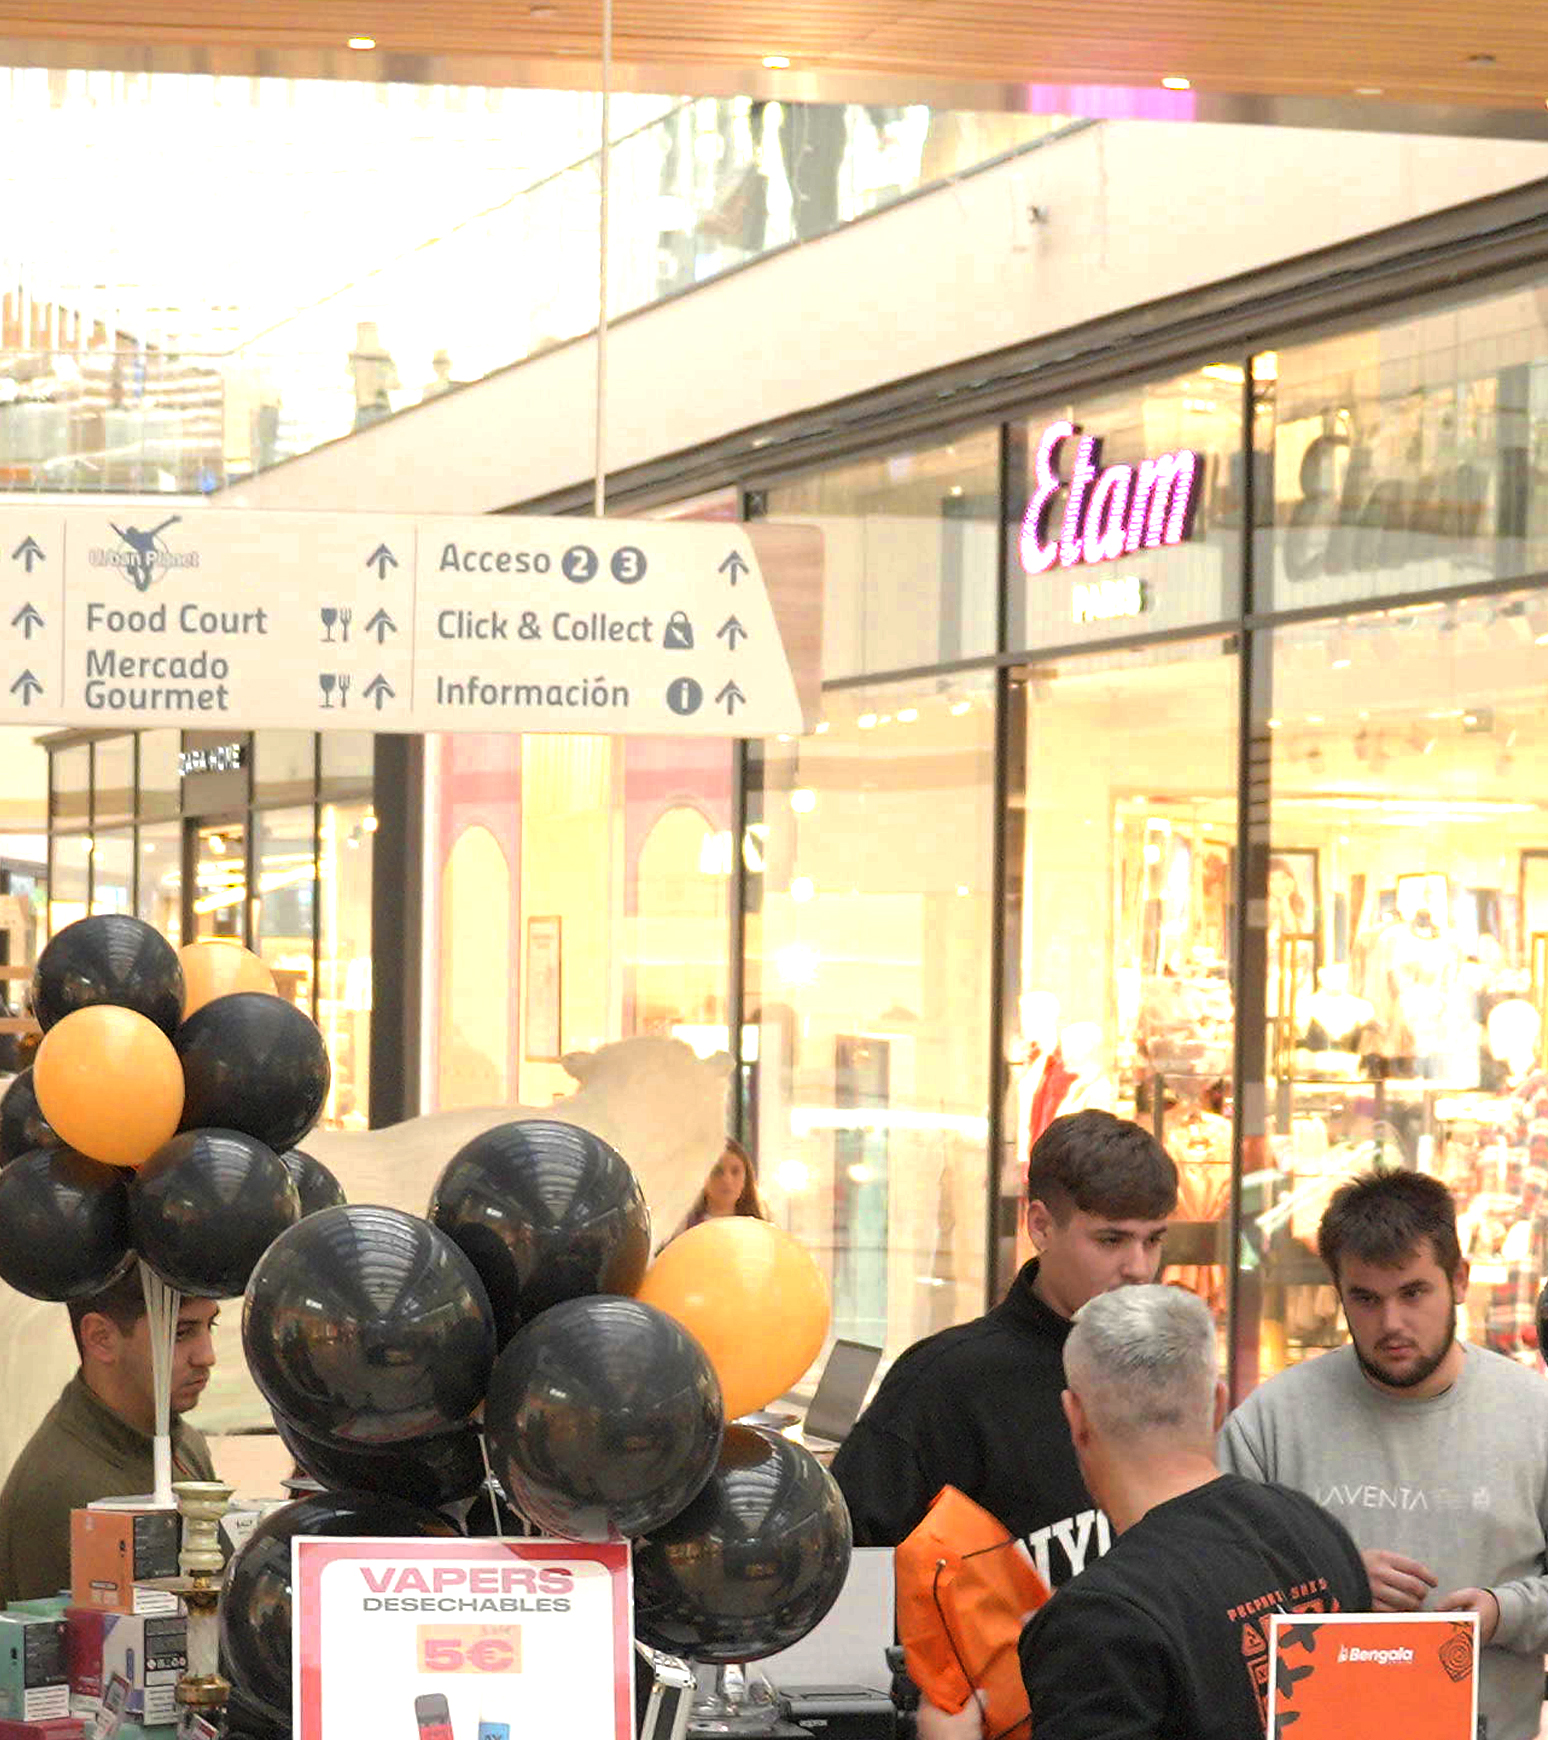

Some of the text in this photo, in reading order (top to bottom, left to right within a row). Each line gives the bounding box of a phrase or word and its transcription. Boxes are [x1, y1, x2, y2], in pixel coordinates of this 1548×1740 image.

[1020, 420, 1198, 574] Etam
[89, 547, 141, 567] Urban
[439, 542, 552, 573] Acceso
[87, 602, 268, 635] Food Court
[437, 609, 653, 643] Click & Collect
[86, 649, 229, 680] Mercado
[85, 680, 229, 711] Gourmet
[436, 674, 630, 708] Información
[359, 1567, 576, 1595] VAPERS
[362, 1597, 572, 1613] DESECHABLES
[424, 1638, 515, 1672] 5€
[1348, 1646, 1415, 1664] Bengala
